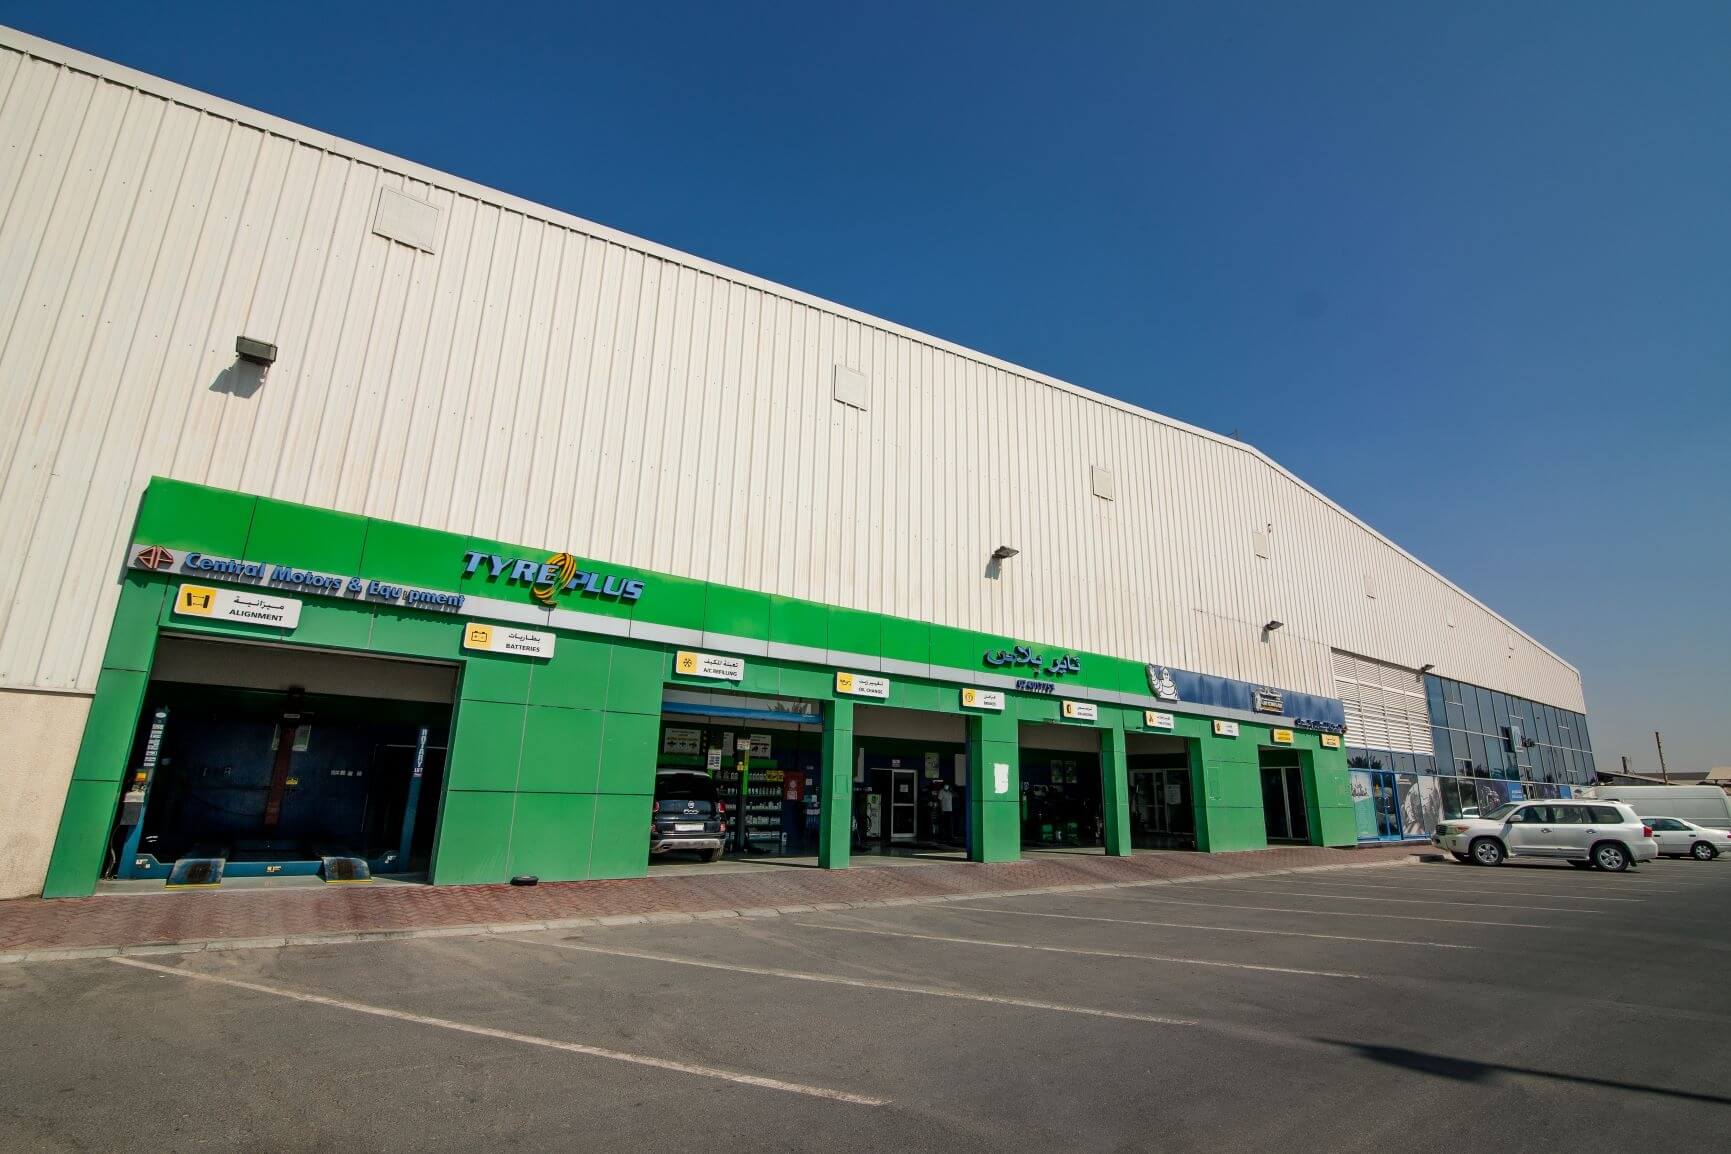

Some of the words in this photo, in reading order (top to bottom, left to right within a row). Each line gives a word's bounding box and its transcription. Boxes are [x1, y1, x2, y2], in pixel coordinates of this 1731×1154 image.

[185, 552, 266, 580] Central
[274, 565, 342, 592] Motors
[348, 578, 362, 593] &
[368, 580, 466, 607] Equpment
[229, 609, 284, 622] ALIGNMENT
[505, 643, 541, 653] BATTERIES
